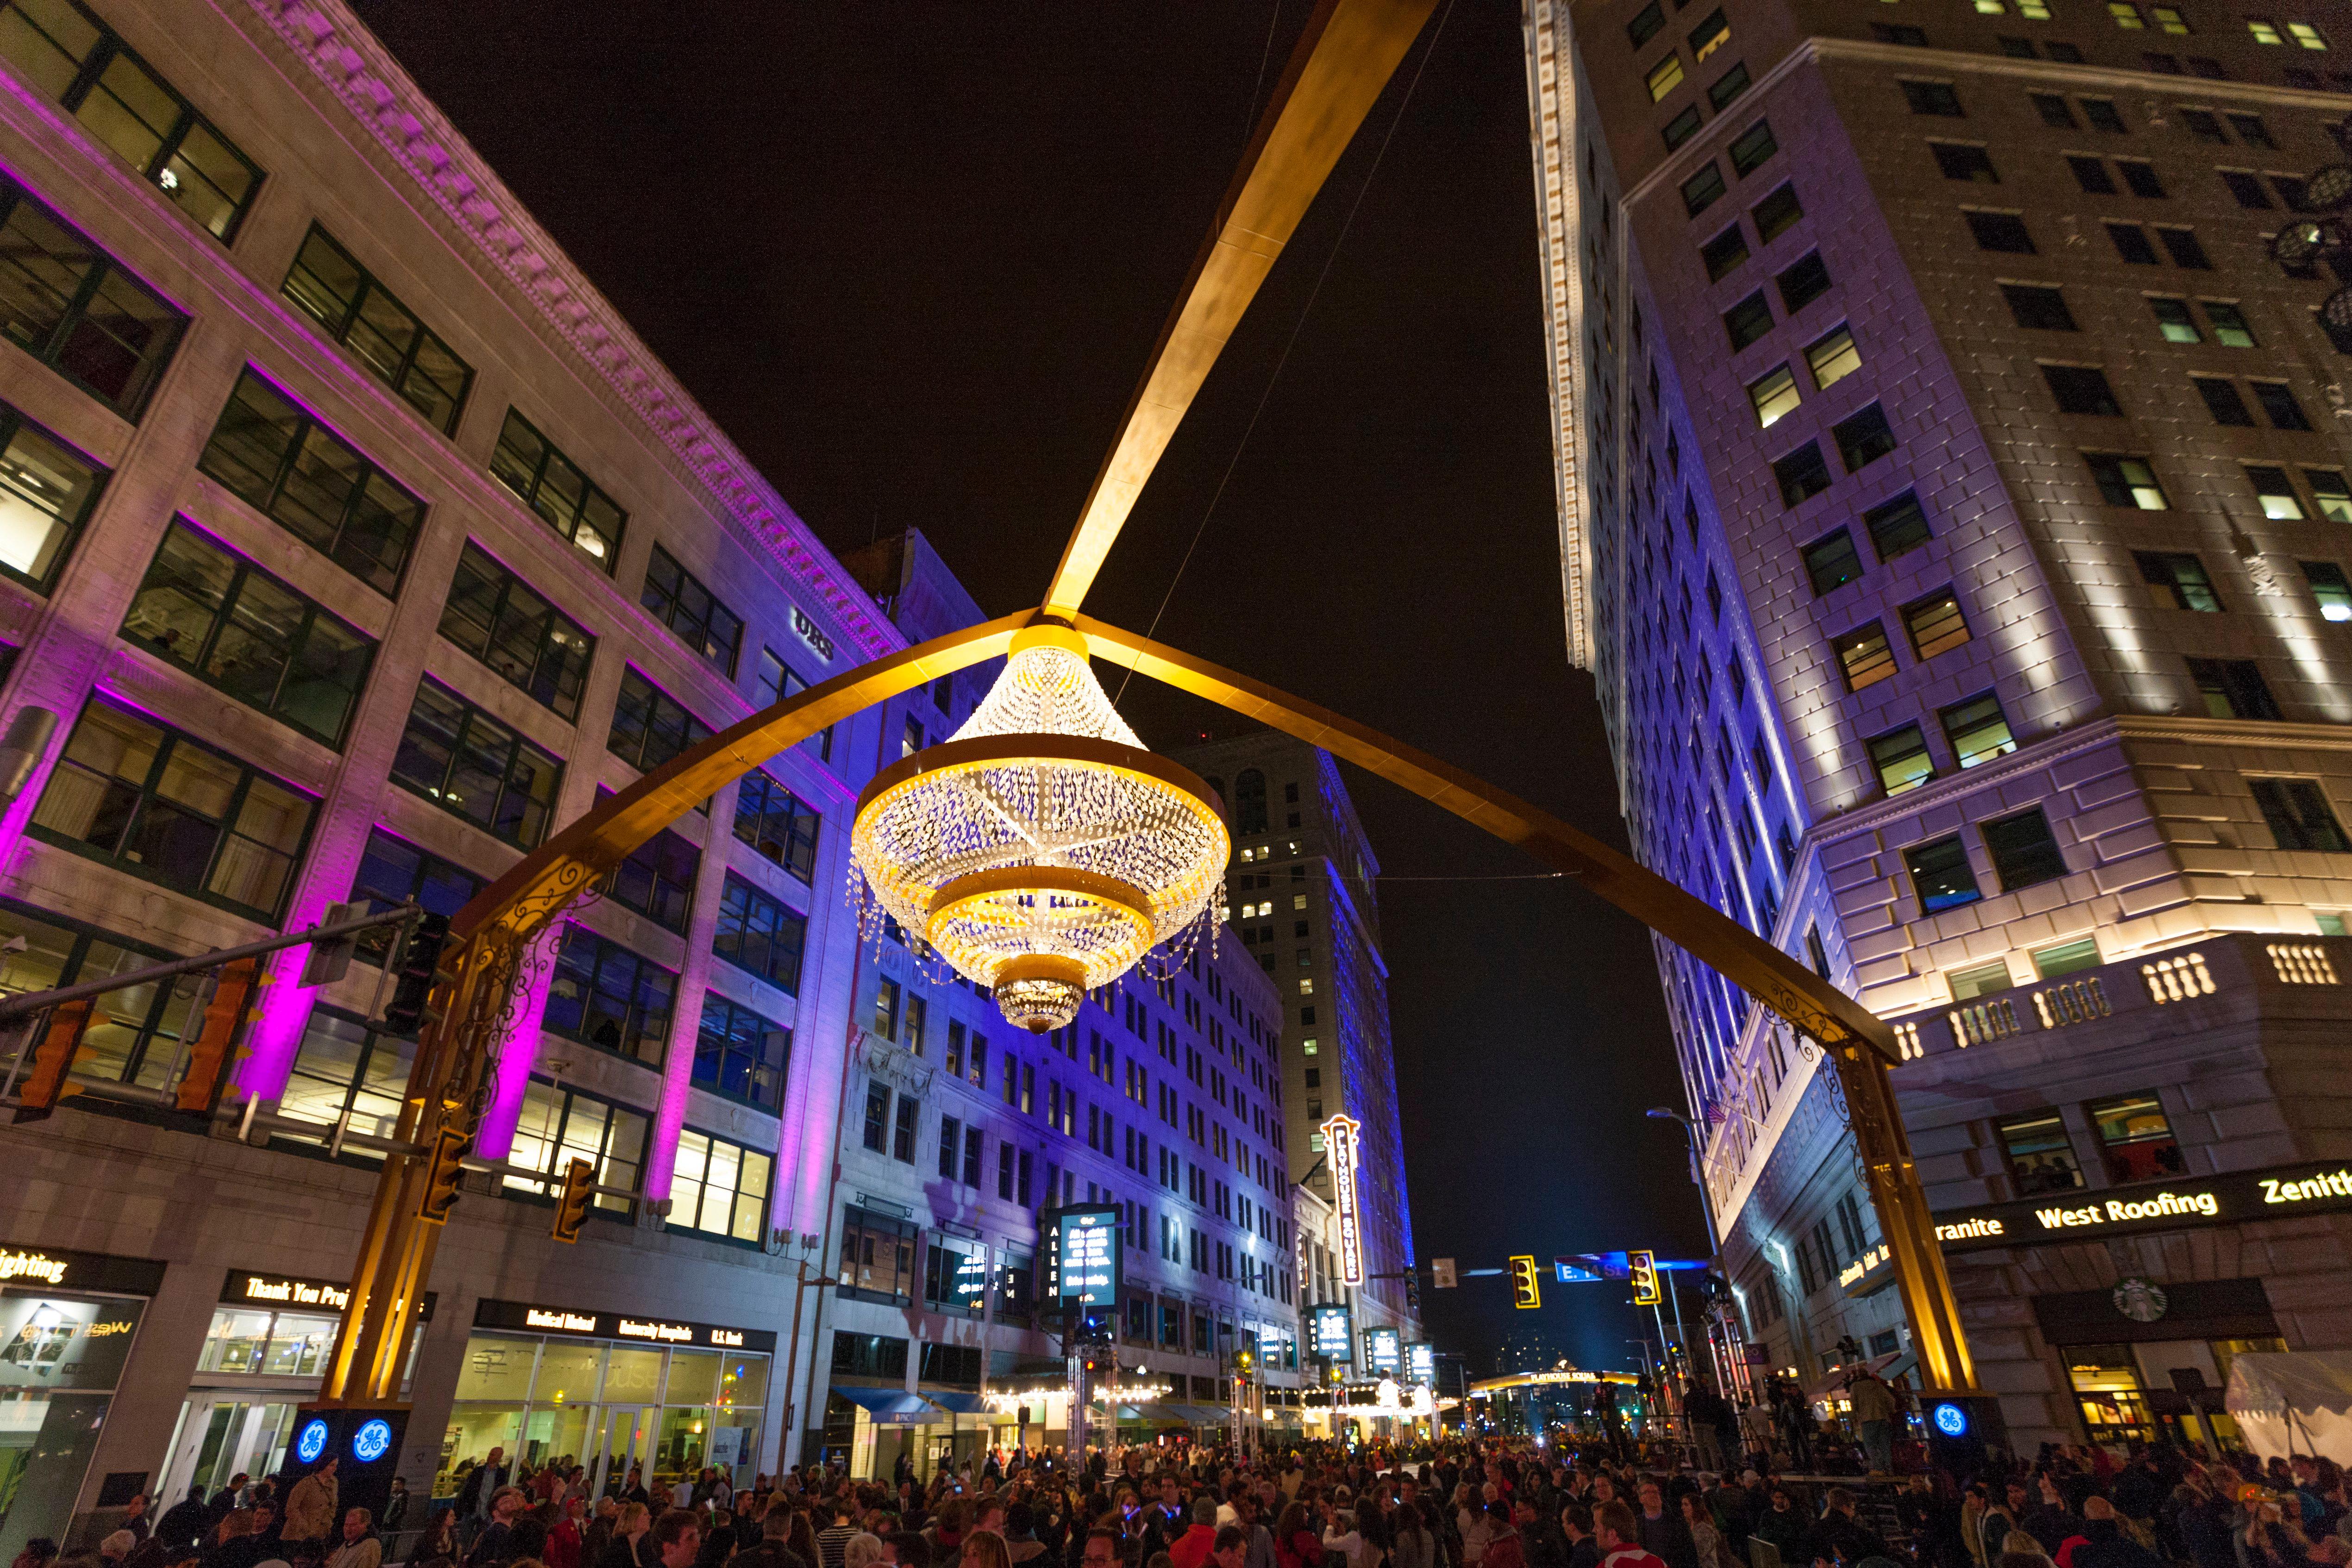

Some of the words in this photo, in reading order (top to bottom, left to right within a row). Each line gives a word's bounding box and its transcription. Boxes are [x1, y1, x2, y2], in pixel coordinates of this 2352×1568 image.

[791, 605, 834, 661] URS
[1336, 1130, 1351, 1214] PLAYHOUSE
[2035, 1206, 2104, 1229] West
[2105, 1192, 2219, 1220] Roofing
[1048, 1226, 1059, 1297] ALLEN
[1342, 1217, 1357, 1279] SQUARE
[1562, 1266, 1577, 1279] E.
[1604, 1264, 1621, 1277] St
[246, 1278, 291, 1300] Thank
[293, 1283, 320, 1303] You
[320, 1286, 351, 1310] Proj
[1309, 1319, 1318, 1351] OHIO
[1530, 1372, 1571, 1382] PLAYHOUSE
